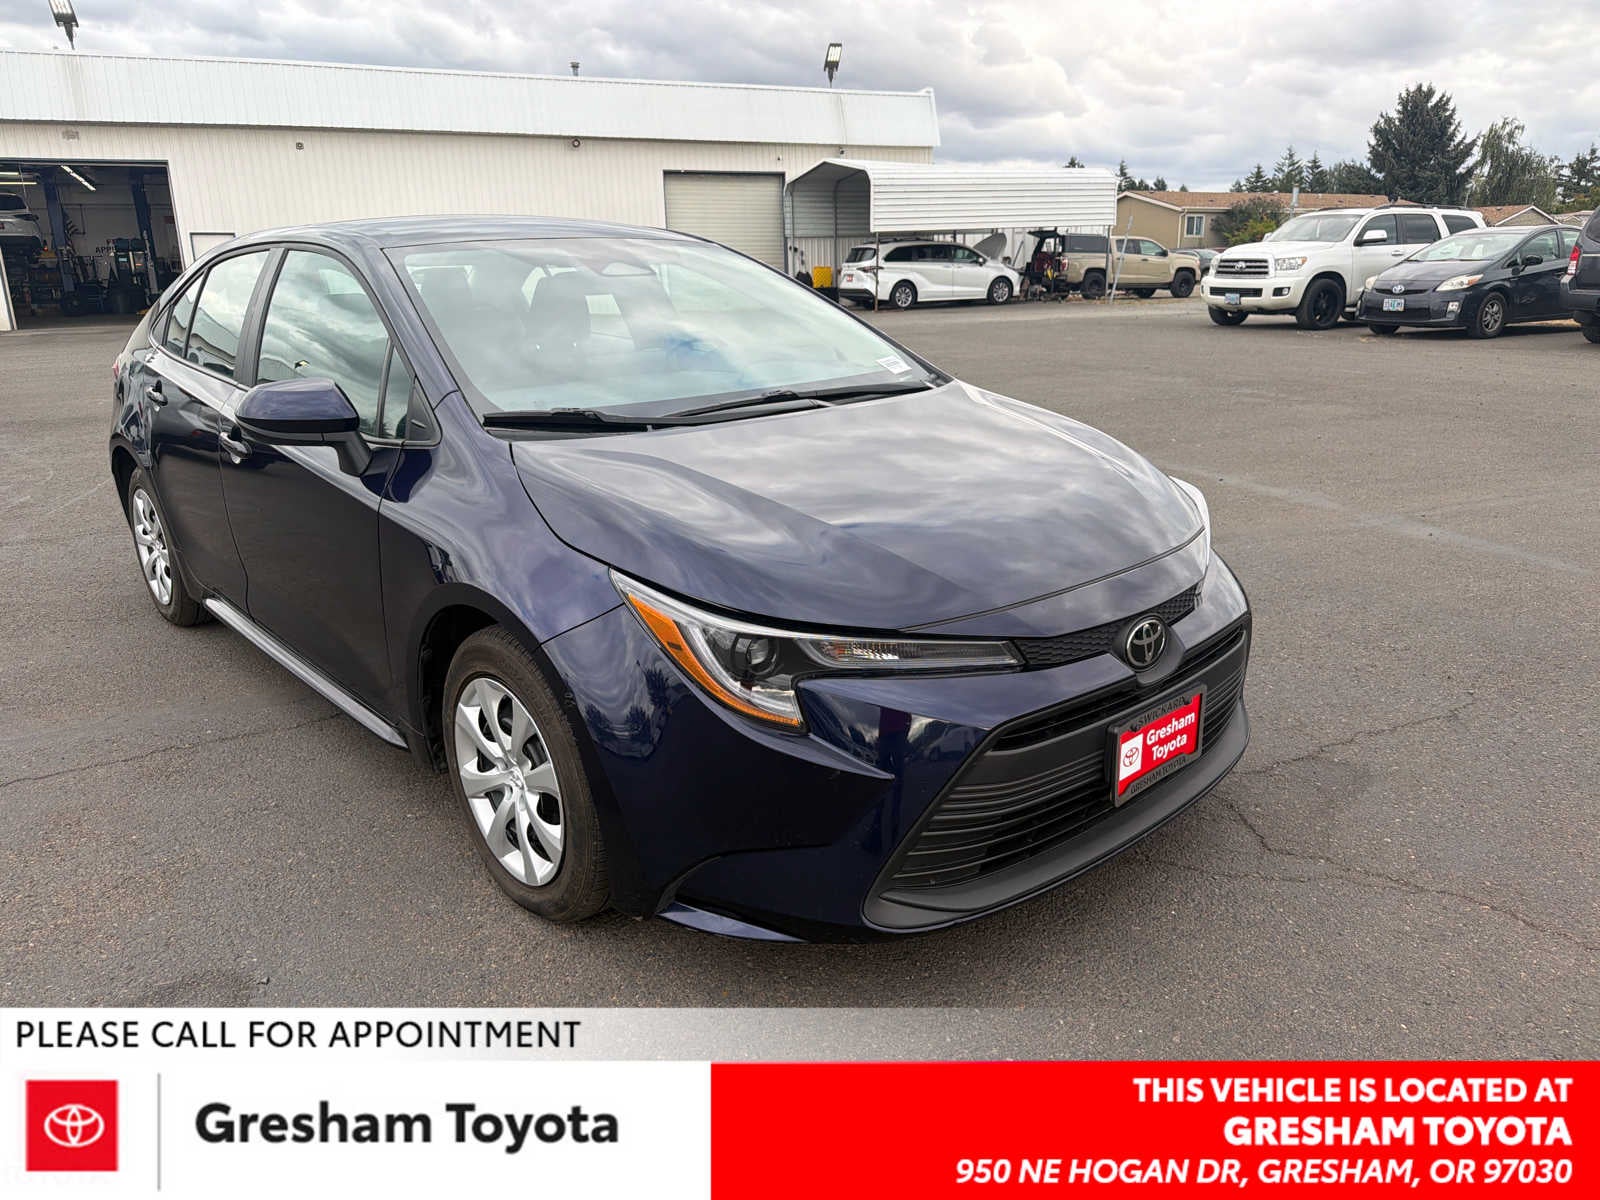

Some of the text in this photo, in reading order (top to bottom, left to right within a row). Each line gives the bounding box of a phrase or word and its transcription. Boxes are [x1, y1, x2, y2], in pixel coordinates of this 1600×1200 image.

[1137, 695, 1186, 726] SWICKARD
[1146, 712, 1195, 746] Gresham
[1151, 733, 1188, 761] Toyota
[1130, 755, 1187, 794] GRESHAM TOYOTA
